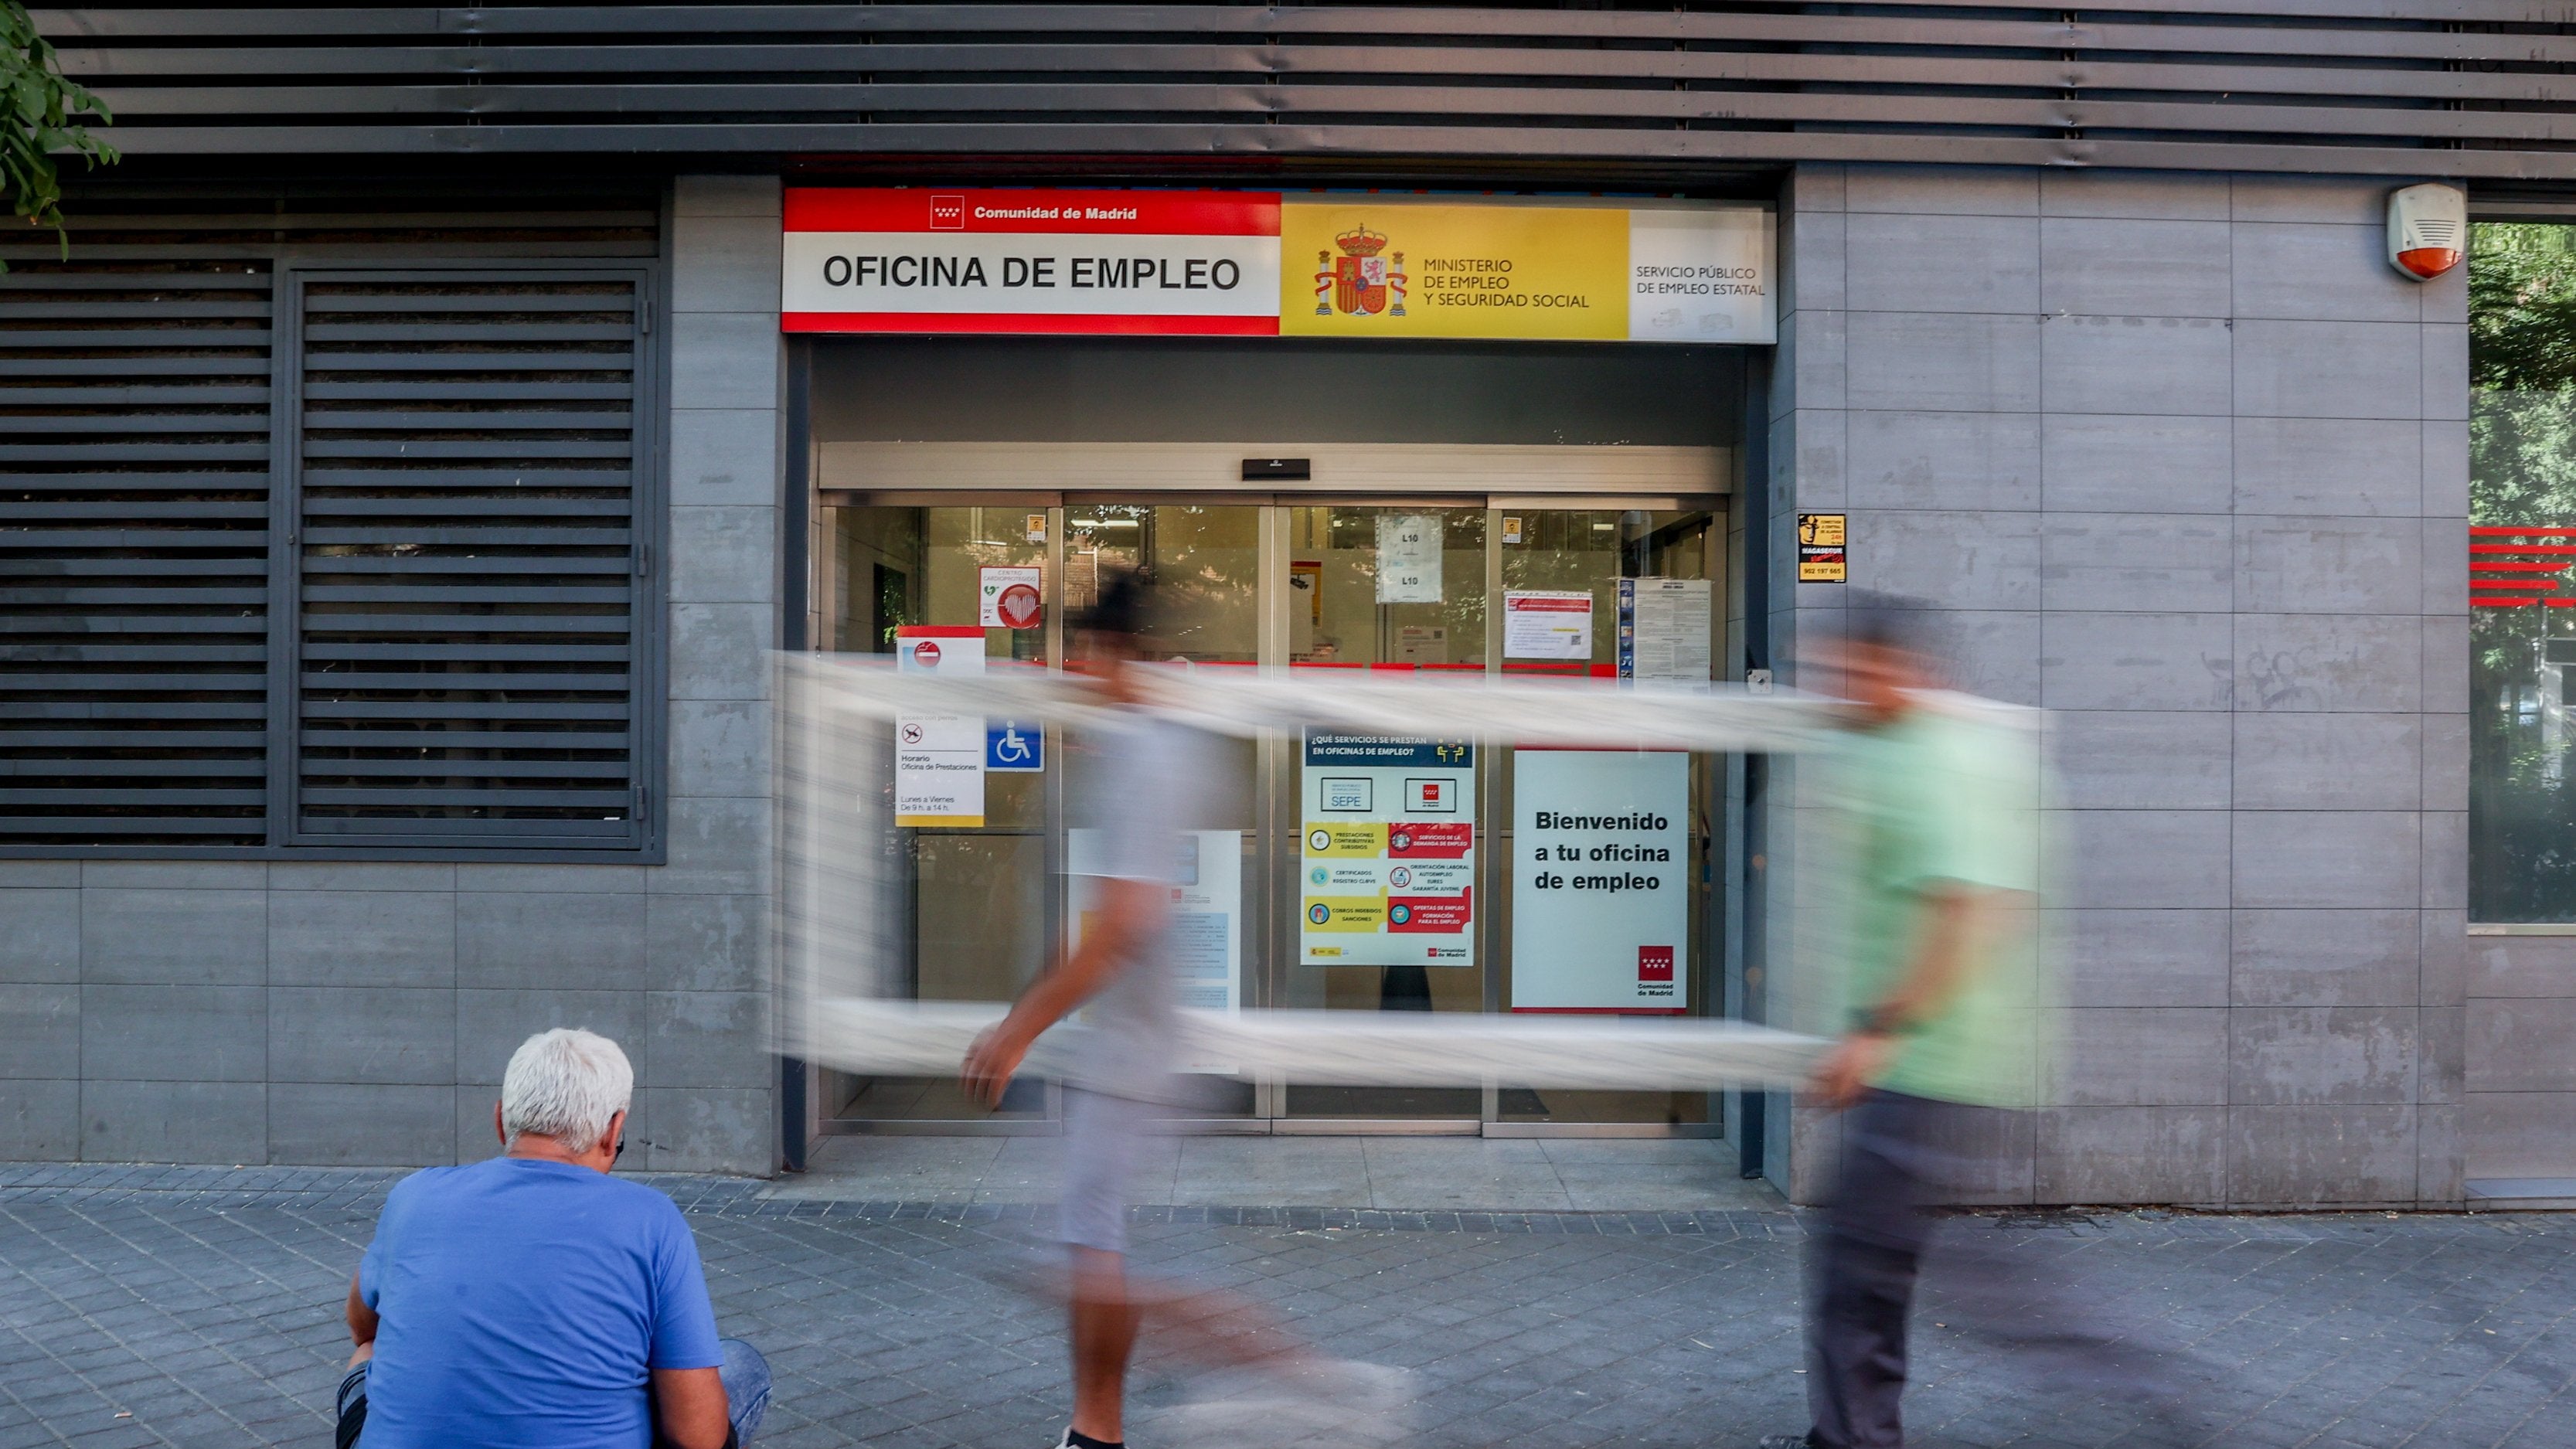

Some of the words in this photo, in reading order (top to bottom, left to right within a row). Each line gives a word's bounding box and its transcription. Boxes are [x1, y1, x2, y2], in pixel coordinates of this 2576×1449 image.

[974, 206, 1060, 219] Comunidad
[1063, 206, 1082, 219] de
[1085, 207, 1138, 220] Madrid
[1424, 259, 1513, 272] MINISTERIO
[1636, 266, 1695, 278] SERVICIO
[1699, 265, 1756, 279] PÚBLICO
[823, 255, 988, 287] OFICINA
[1004, 257, 1056, 288] DE
[1071, 257, 1240, 291] EMPLEO
[1424, 276, 1445, 288] DE
[1449, 276, 1509, 290] EMPLEO
[1637, 283, 1655, 294] DE
[1659, 283, 1710, 294] EMPLEO
[1713, 284, 1766, 296] ESTATAL
[1423, 293, 1434, 305] Y
[1438, 293, 1528, 307] SEGURIDAD
[1532, 294, 1590, 308] SOCIAL
[1402, 534, 1419, 543] L10
[1402, 577, 1419, 586] L10
[1312, 734, 1333, 745] ¿QUÉ
[1334, 736, 1377, 744] SERVICIOS
[1390, 736, 1428, 745] PRESTAN
[1325, 747, 1364, 756] OFICINAS
[1366, 747, 1376, 756] DE
[1377, 747, 1414, 756] EMPLEO?
[1332, 796, 1361, 807] SEPE
[1535, 811, 1669, 831] Bienvenido
[1535, 847, 1549, 862] a
[1557, 844, 1581, 862] tu
[1589, 844, 1670, 862] oficina
[1535, 871, 1564, 889] de
[1572, 872, 1660, 893] empleo
